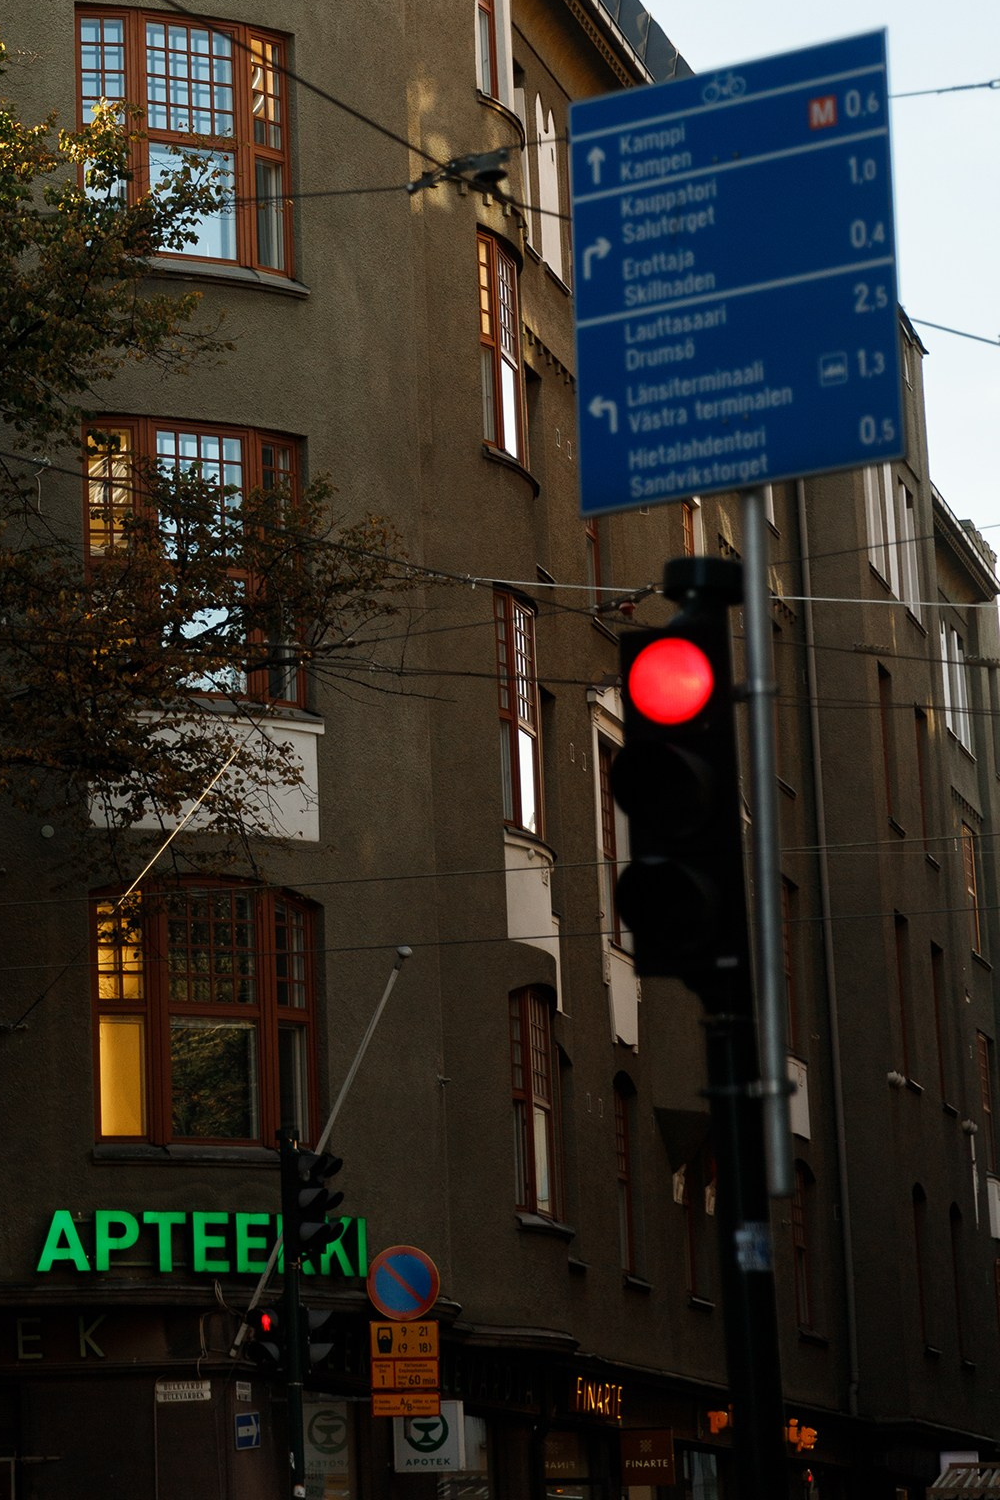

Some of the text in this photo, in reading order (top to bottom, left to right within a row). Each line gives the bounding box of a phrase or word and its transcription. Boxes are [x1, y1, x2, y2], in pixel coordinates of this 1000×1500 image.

[811, 98, 835, 128] M
[620, 122, 685, 155] Kamppi
[620, 152, 692, 182] Kampen
[621, 178, 717, 218] Kauppatori
[622, 205, 715, 244] Salutorget
[623, 249, 695, 281] Erottaja
[624, 273, 716, 307] Skillnaden
[625, 304, 727, 344] Lauttasaari
[626, 337, 695, 371] Drumsö
[627, 361, 764, 407] Länsiterminaali
[628, 386, 793, 433] Västra terminalen
[628, 426, 766, 470] Hietalahdentori
[630, 453, 768, 498] Sandvikstorget
[36, 1209, 368, 1278] APTEEKI
[408, 1375, 421, 1385] 60
[406, 1458, 451, 1466] APOTEK
[625, 1459, 669, 1468] FINARTE
